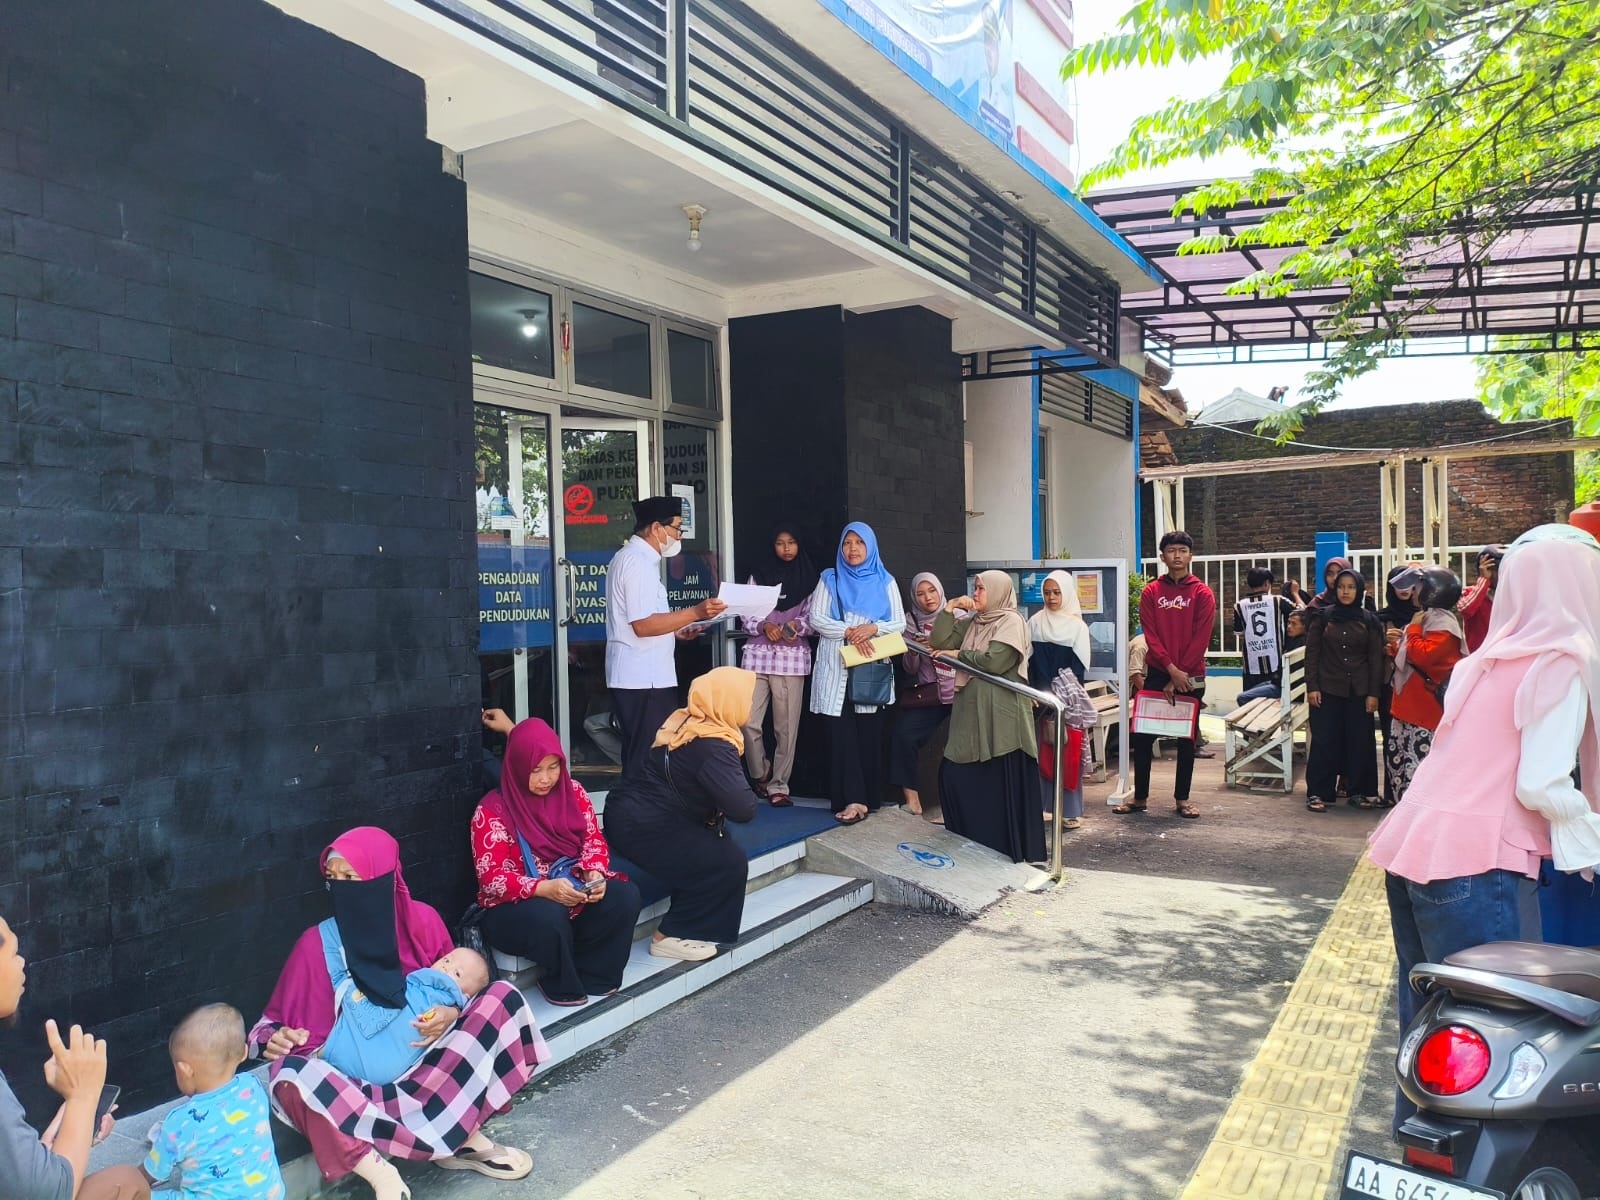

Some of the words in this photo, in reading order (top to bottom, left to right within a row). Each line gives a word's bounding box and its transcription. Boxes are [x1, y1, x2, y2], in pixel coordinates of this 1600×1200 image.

[684, 575, 699, 585] JAM
[495, 591, 522, 604] DATA
[1251, 610, 1268, 637] 6
[1355, 1166, 1380, 1194] AA
